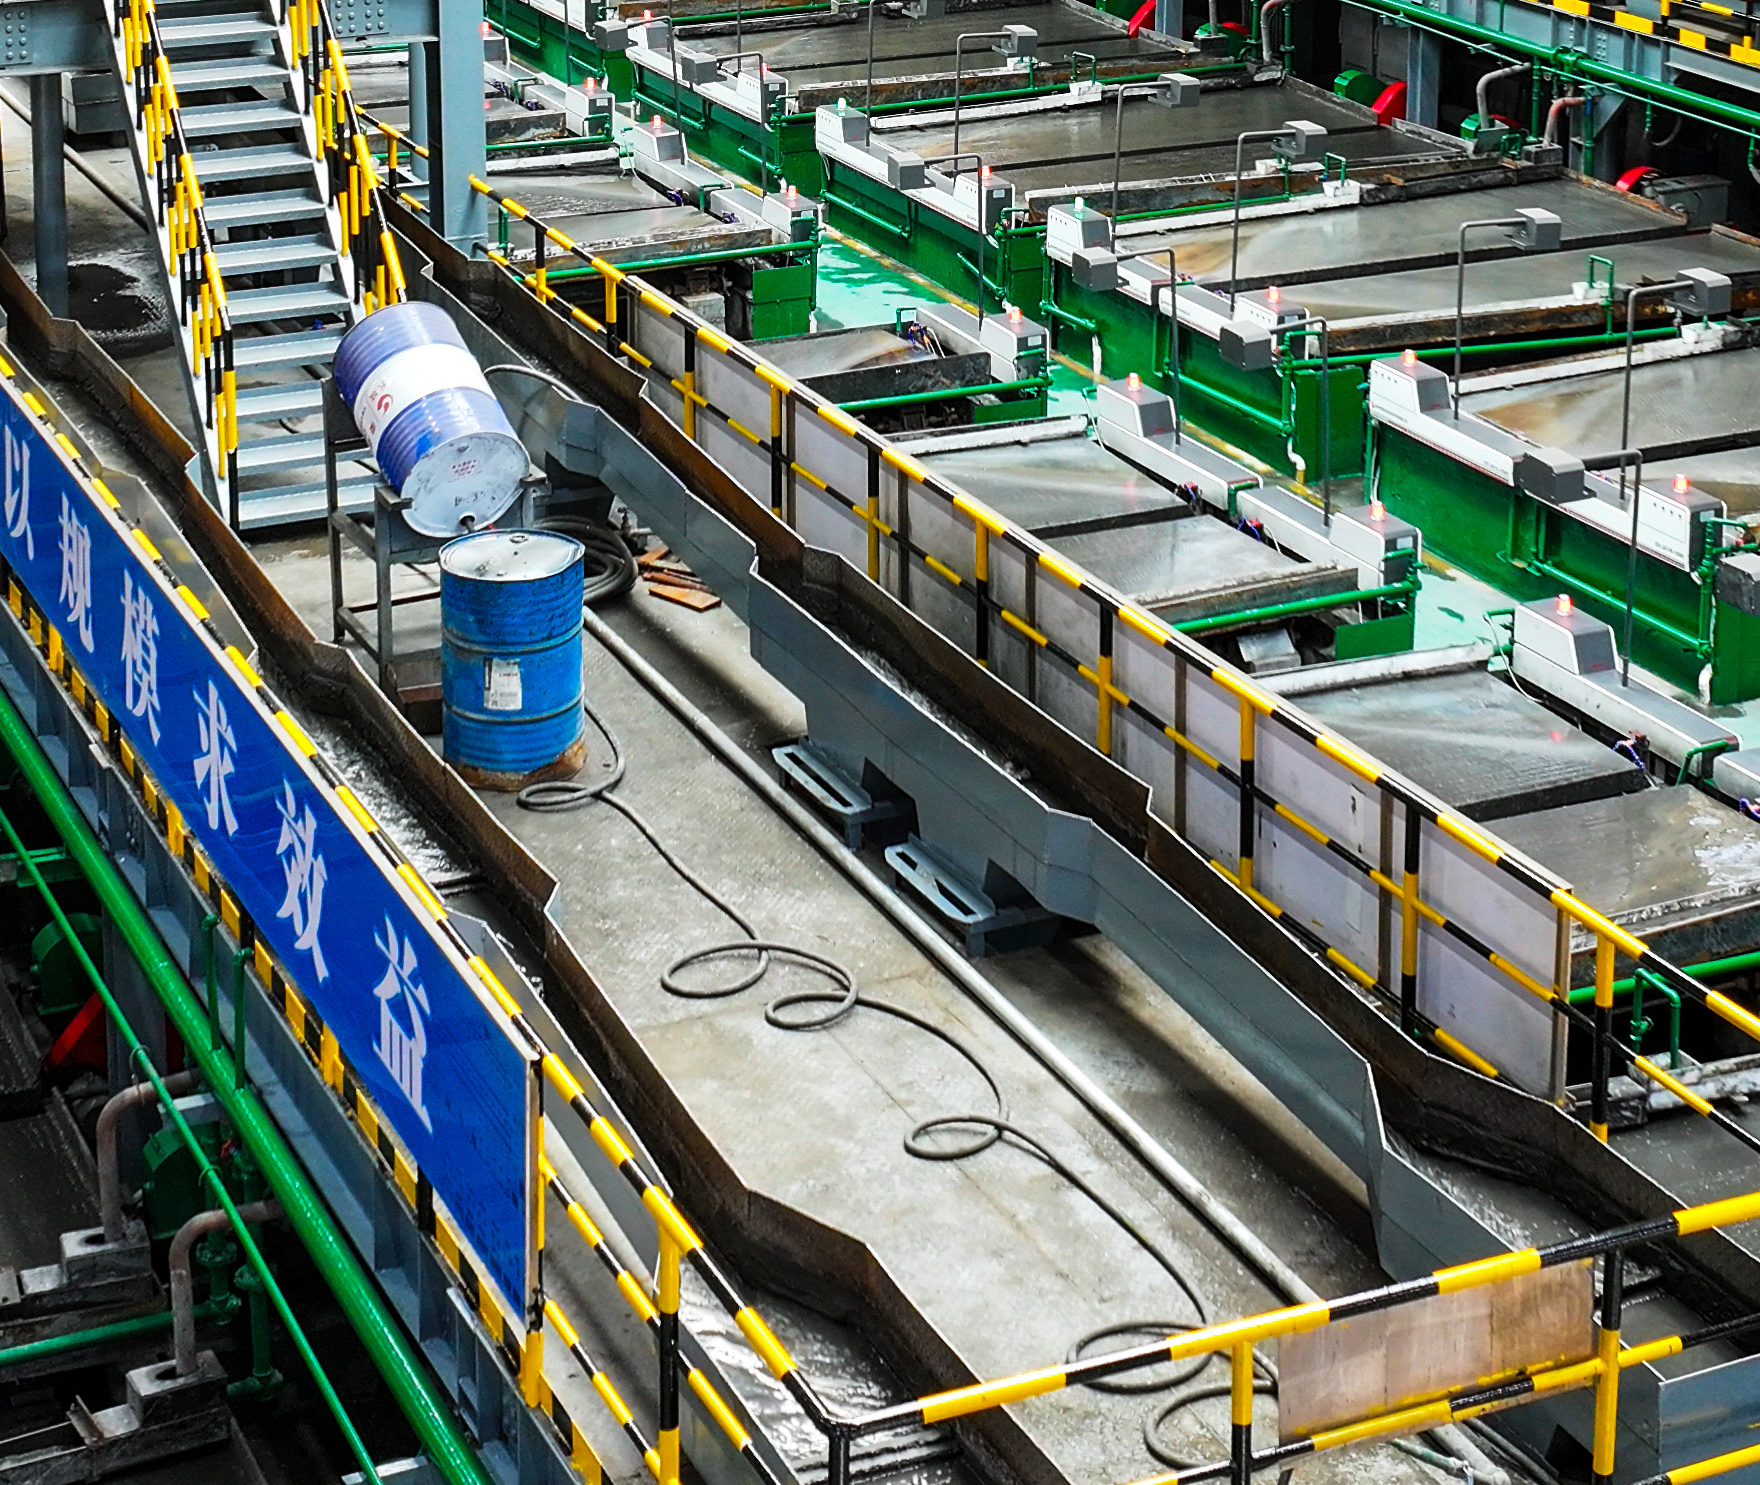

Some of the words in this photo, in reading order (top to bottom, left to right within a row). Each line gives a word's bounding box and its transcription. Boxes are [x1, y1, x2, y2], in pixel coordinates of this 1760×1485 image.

[3, 424, 433, 1134] 以规模求效益
